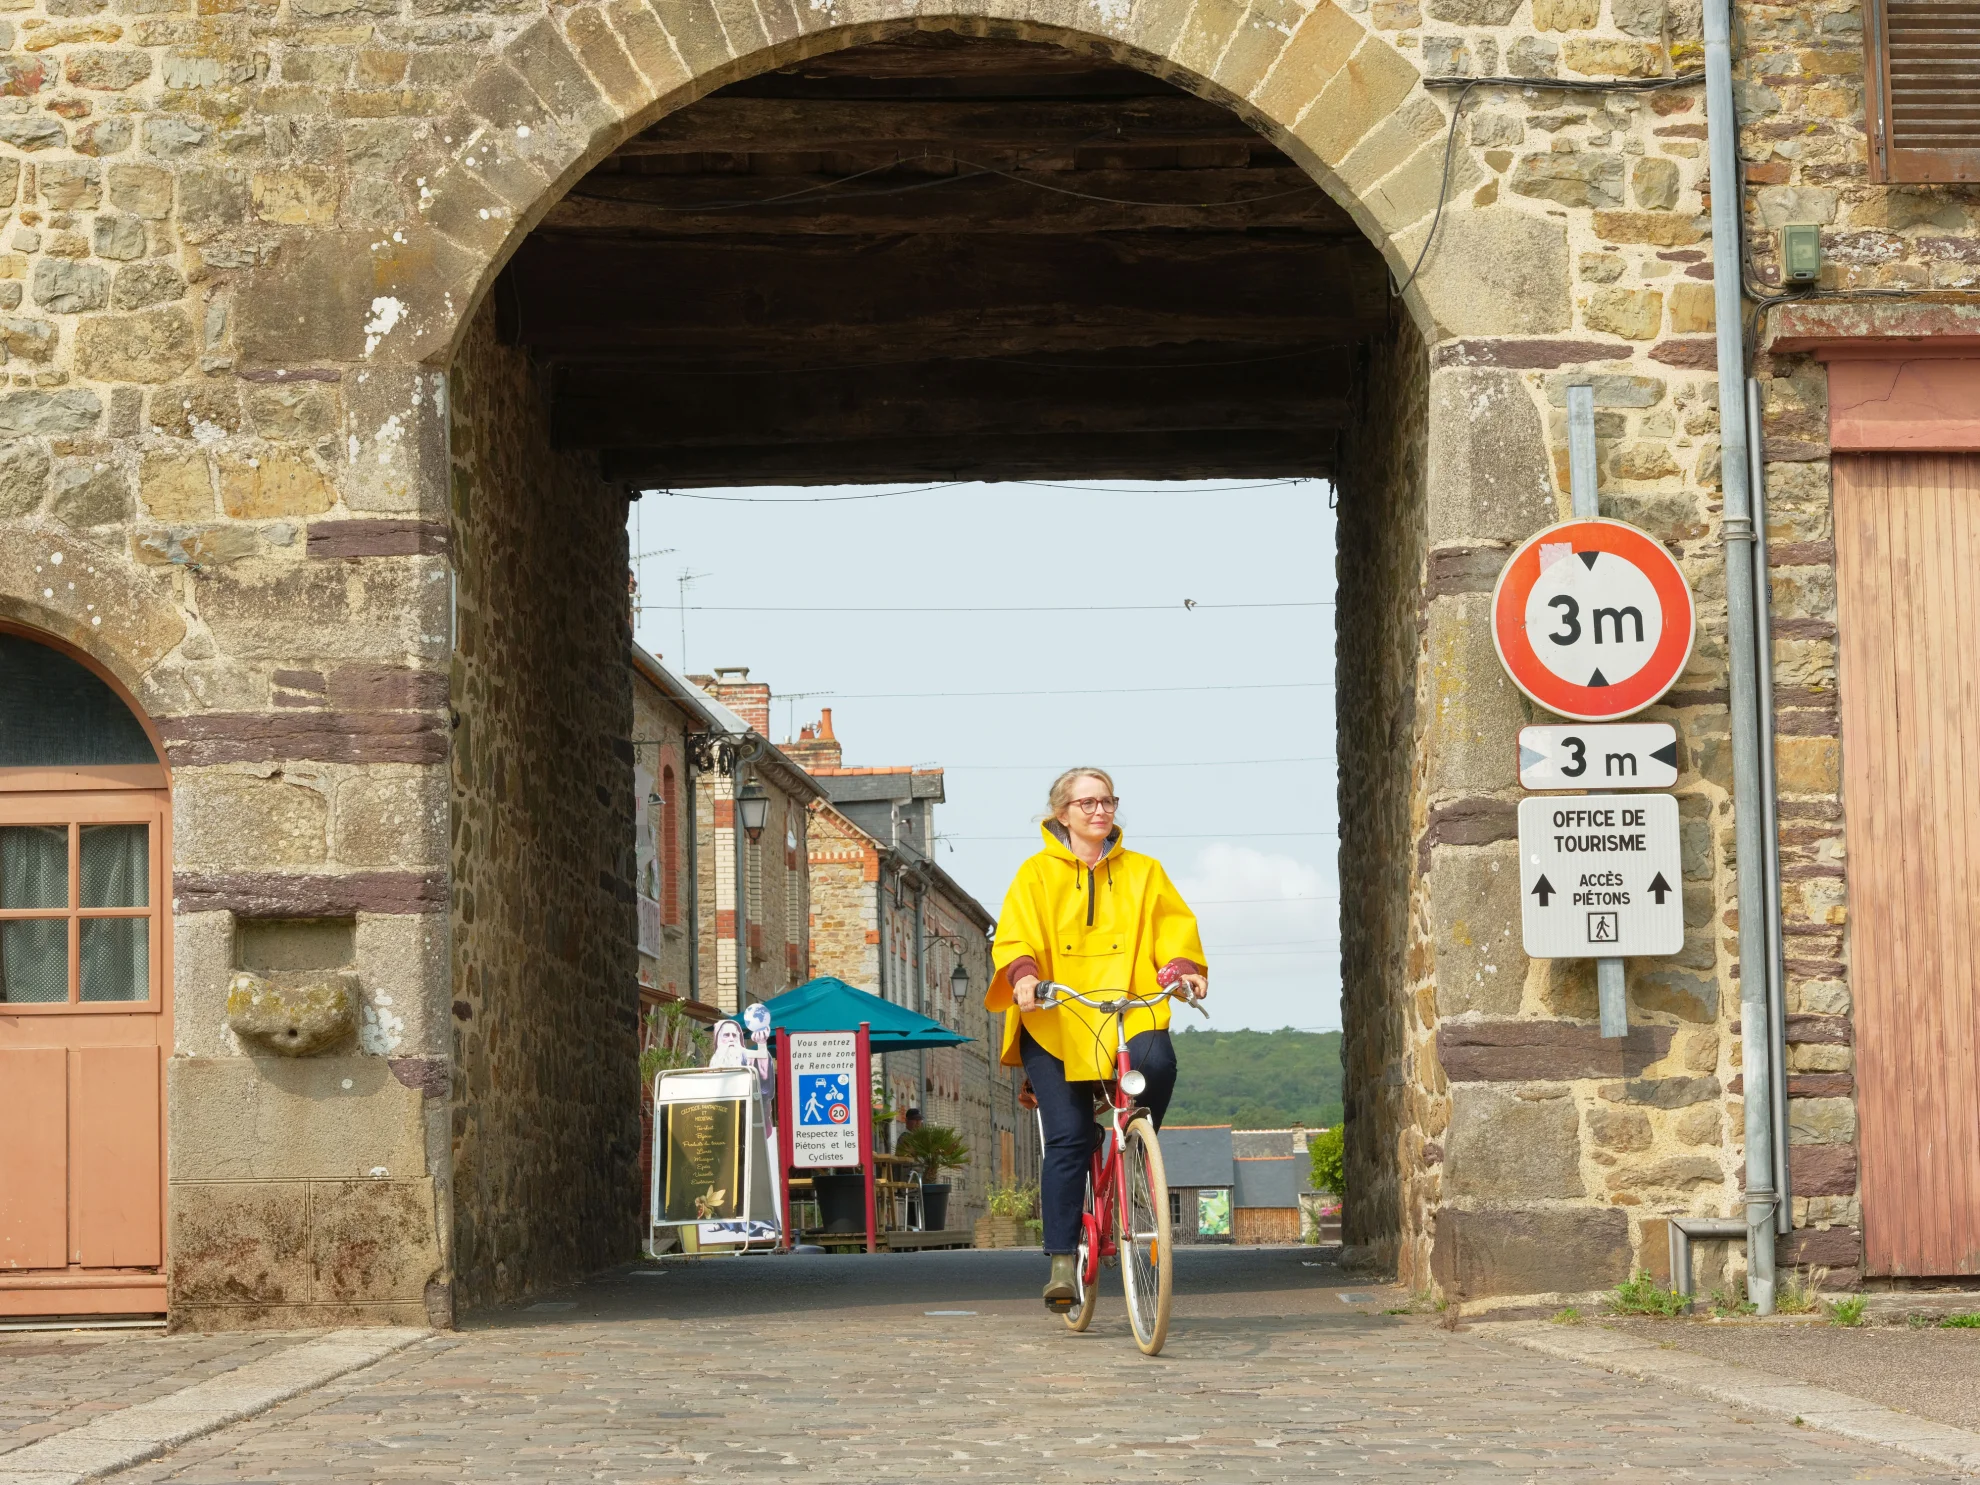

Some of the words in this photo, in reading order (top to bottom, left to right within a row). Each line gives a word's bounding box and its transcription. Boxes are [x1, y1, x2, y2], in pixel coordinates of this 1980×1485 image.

[1547, 594, 1582, 646] 3
[1592, 605, 1645, 645] m
[1560, 736, 1587, 778] 3
[1605, 752, 1638, 777] m
[1552, 809, 1616, 828] OFFICE
[1622, 809, 1646, 827] DE
[1553, 834, 1647, 853] TOURISME
[1579, 870, 1624, 887] ACCÈS
[1573, 889, 1631, 906] PIÉTONS
[797, 1039, 818, 1047] Vous
[822, 1039, 851, 1047] entrez
[792, 1051, 813, 1059] dans
[794, 1062, 805, 1070] de
[808, 1062, 855, 1070] Rencontre
[833, 1109, 845, 1118] 20
[796, 1130, 838, 1140] Respectez
[842, 1129, 855, 1137] les
[795, 1141, 826, 1150] Piétons
[844, 1140, 857, 1149] les
[808, 1152, 844, 1163] Cyclistes
